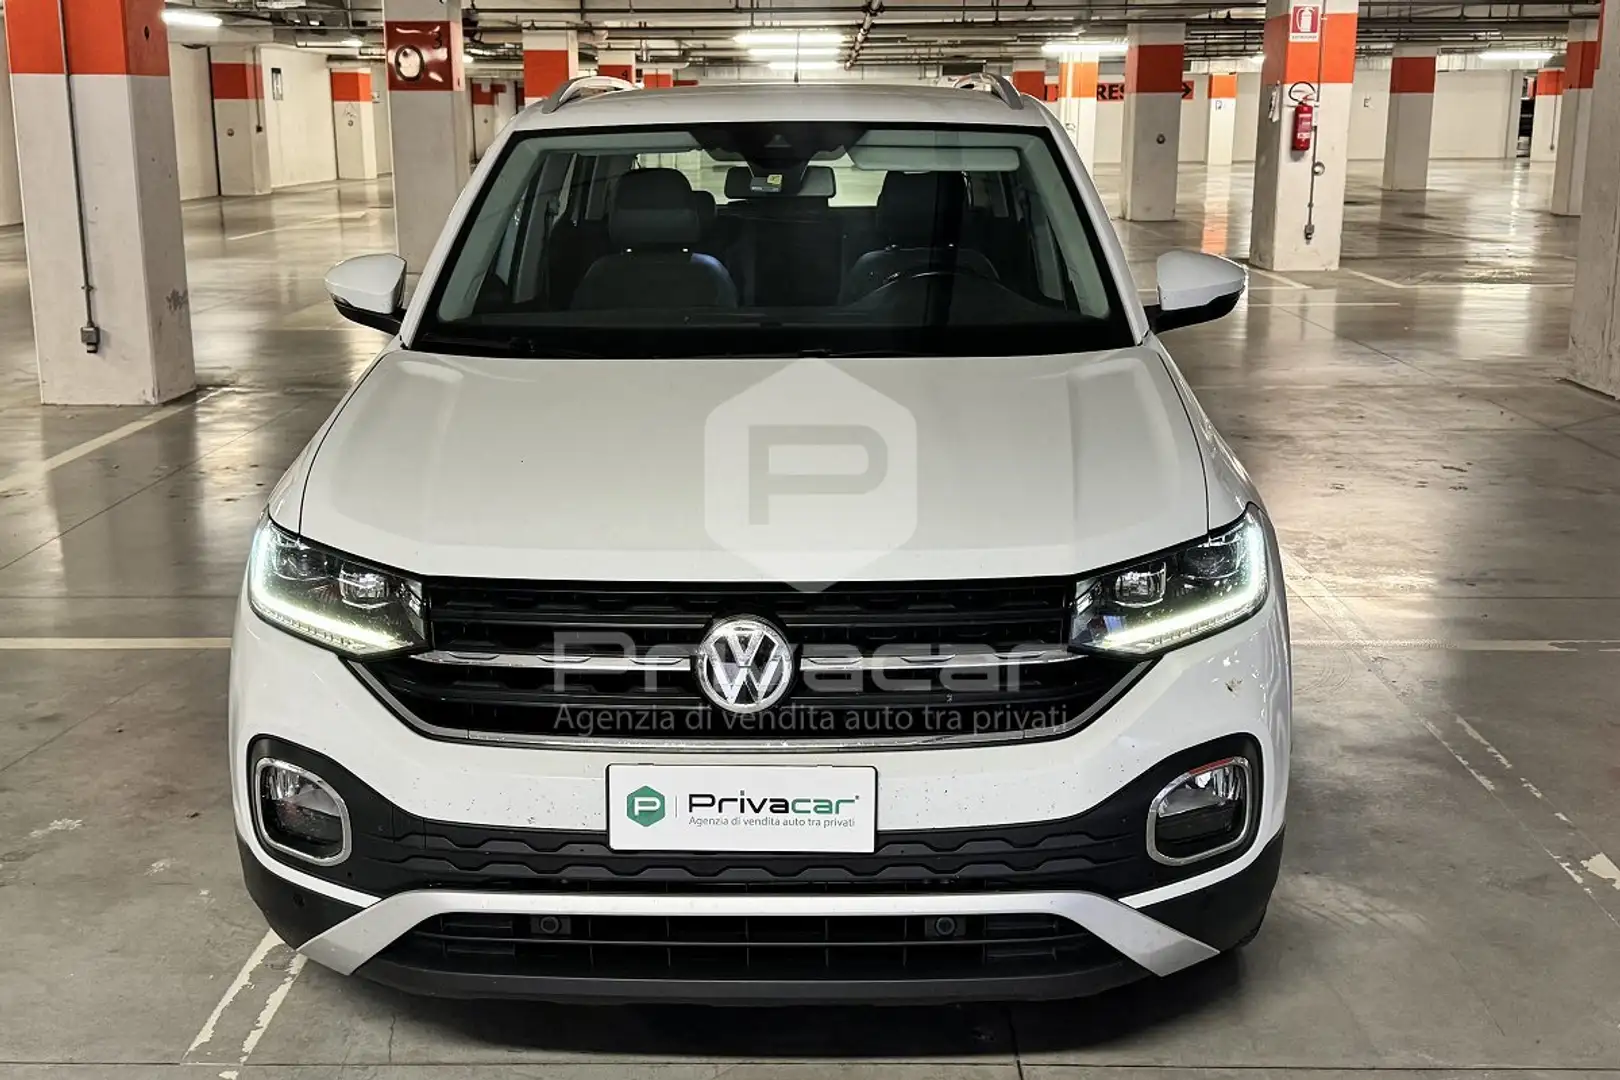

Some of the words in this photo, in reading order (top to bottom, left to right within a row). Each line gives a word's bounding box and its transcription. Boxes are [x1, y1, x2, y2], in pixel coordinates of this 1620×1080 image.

[689, 817, 729, 827] Agenzia
[731, 817, 741, 826] di
[743, 817, 780, 826] vendita
[782, 818, 806, 826] auto
[808, 818, 821, 826] tra
[824, 817, 855, 828] privati
